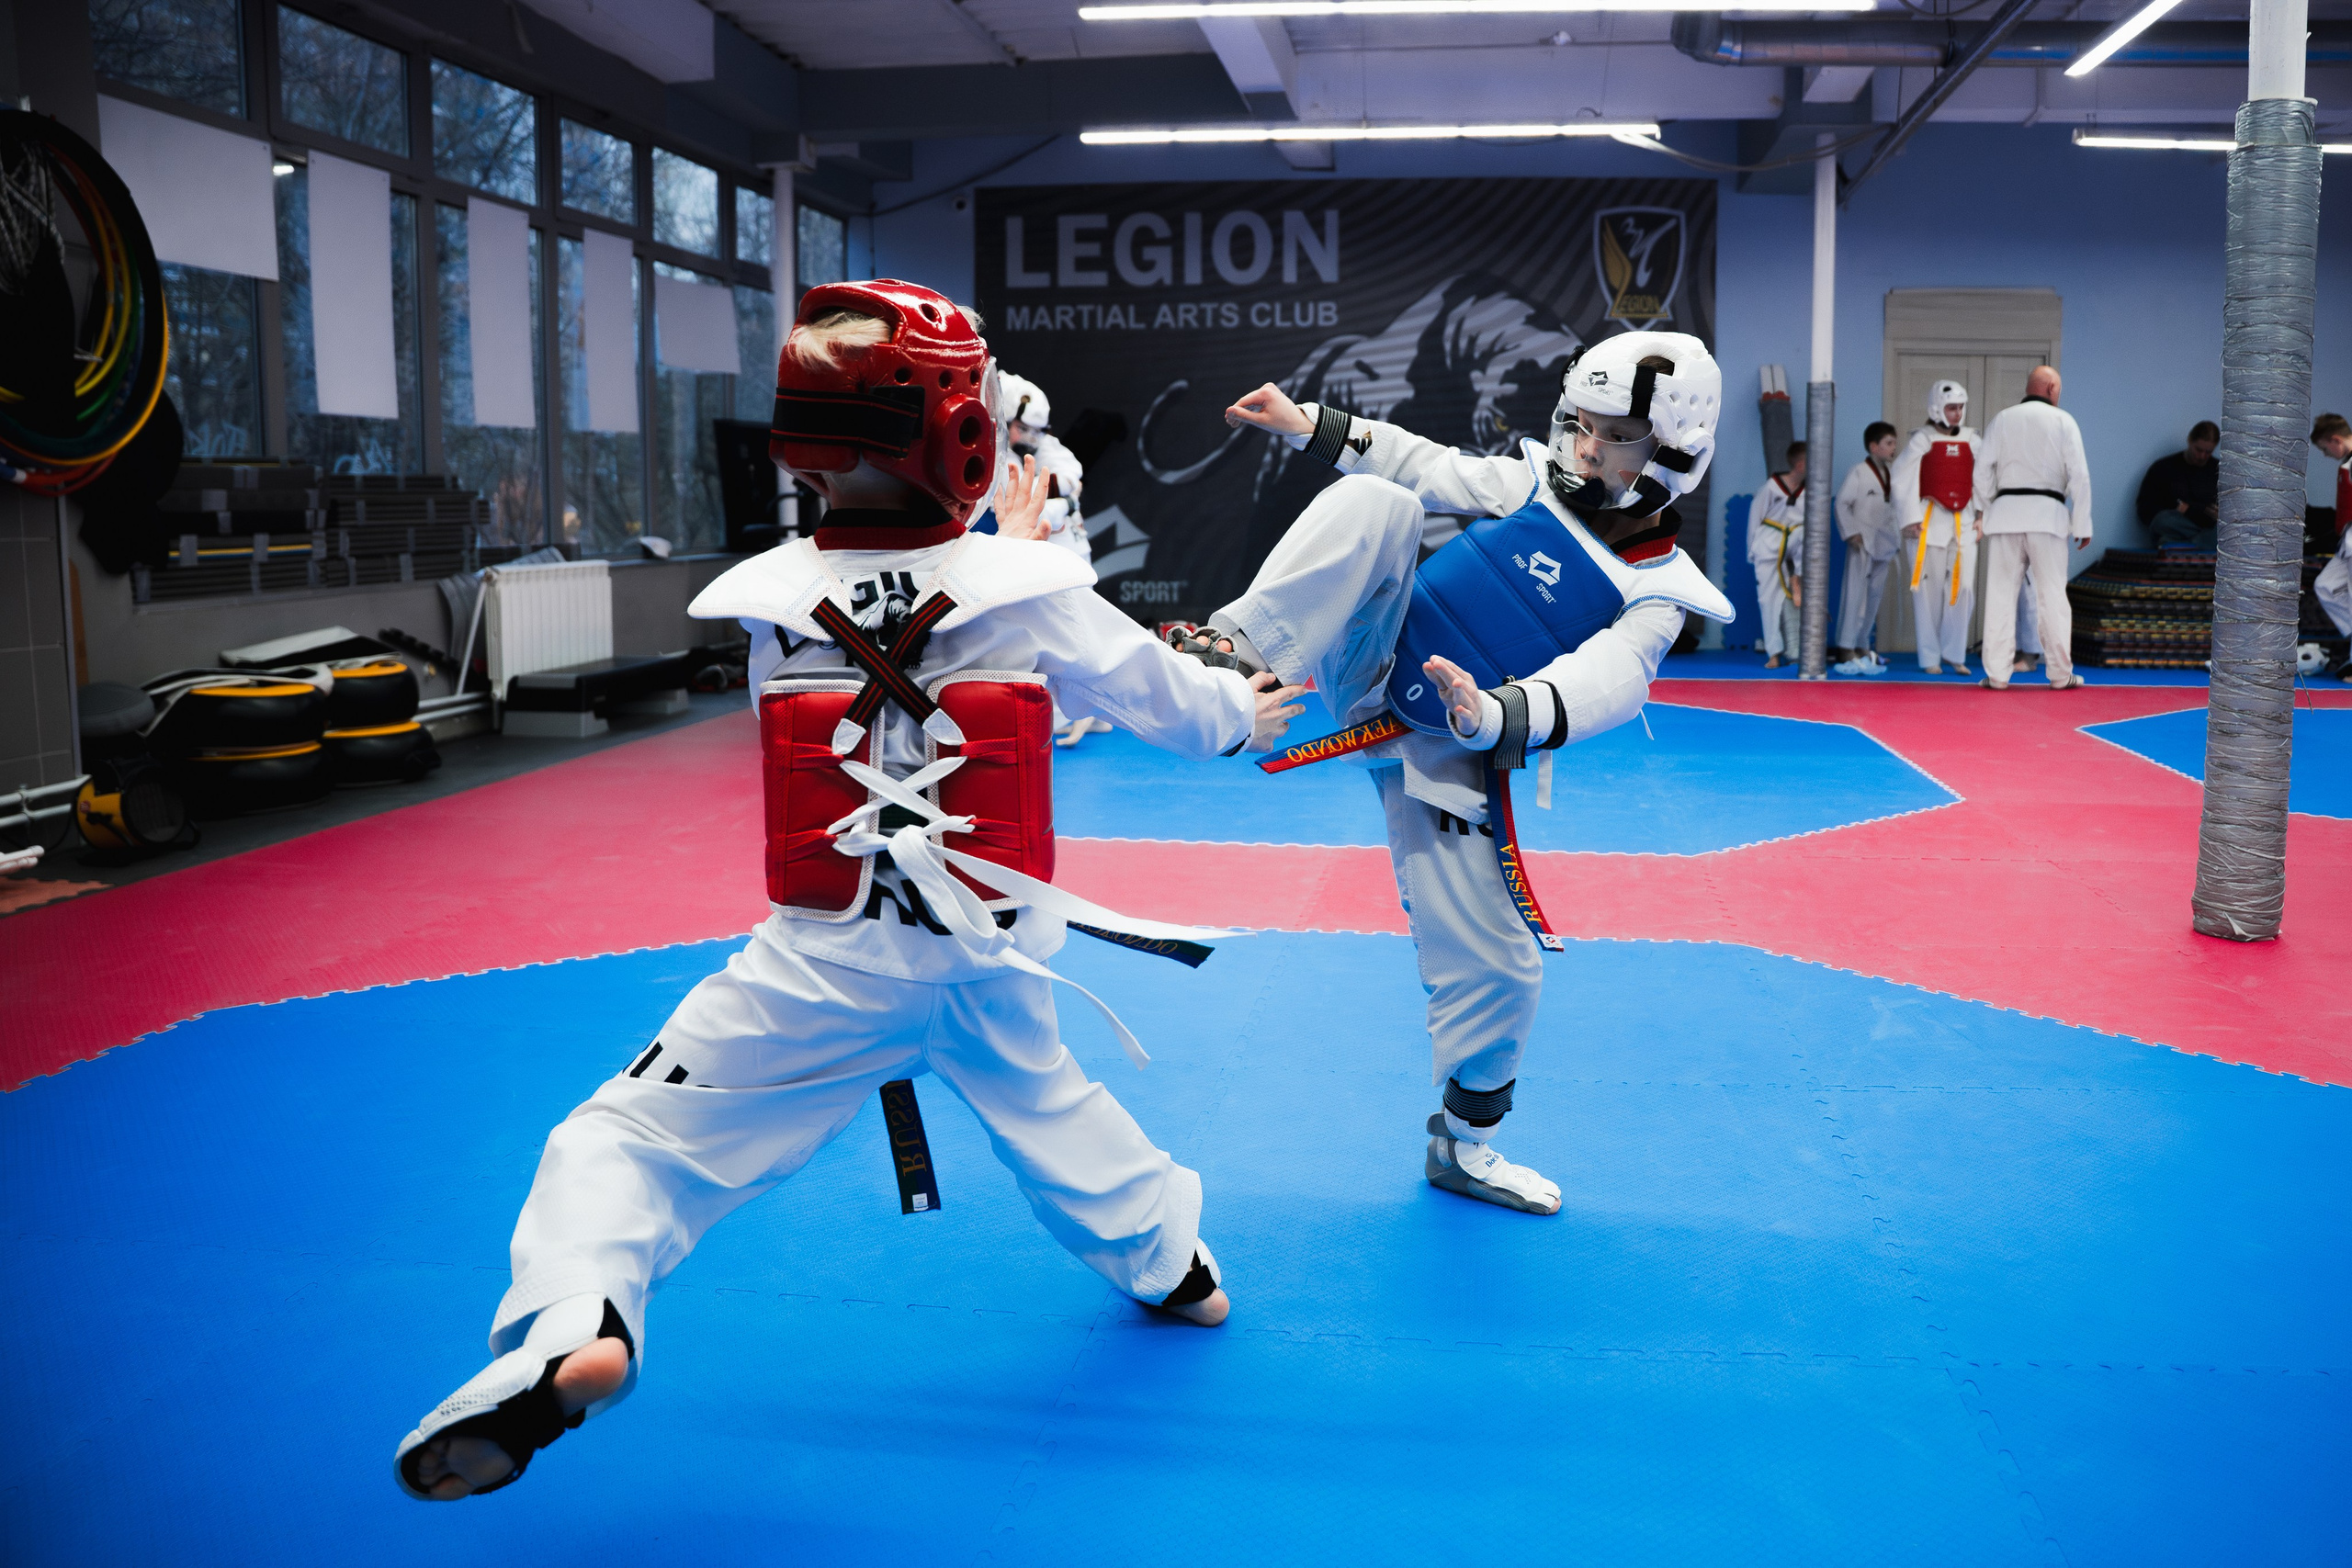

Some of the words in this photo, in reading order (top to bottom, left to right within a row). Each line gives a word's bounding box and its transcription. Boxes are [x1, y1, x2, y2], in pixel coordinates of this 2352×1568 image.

[1006, 209, 1339, 288] LEGION
[1006, 304, 1146, 331] MARTIAL
[1153, 302, 1239, 329] ARTS
[1250, 300, 1339, 327] CLUB
[1511, 553, 1528, 570] PROF
[1499, 840, 1543, 923] RUSSIA
